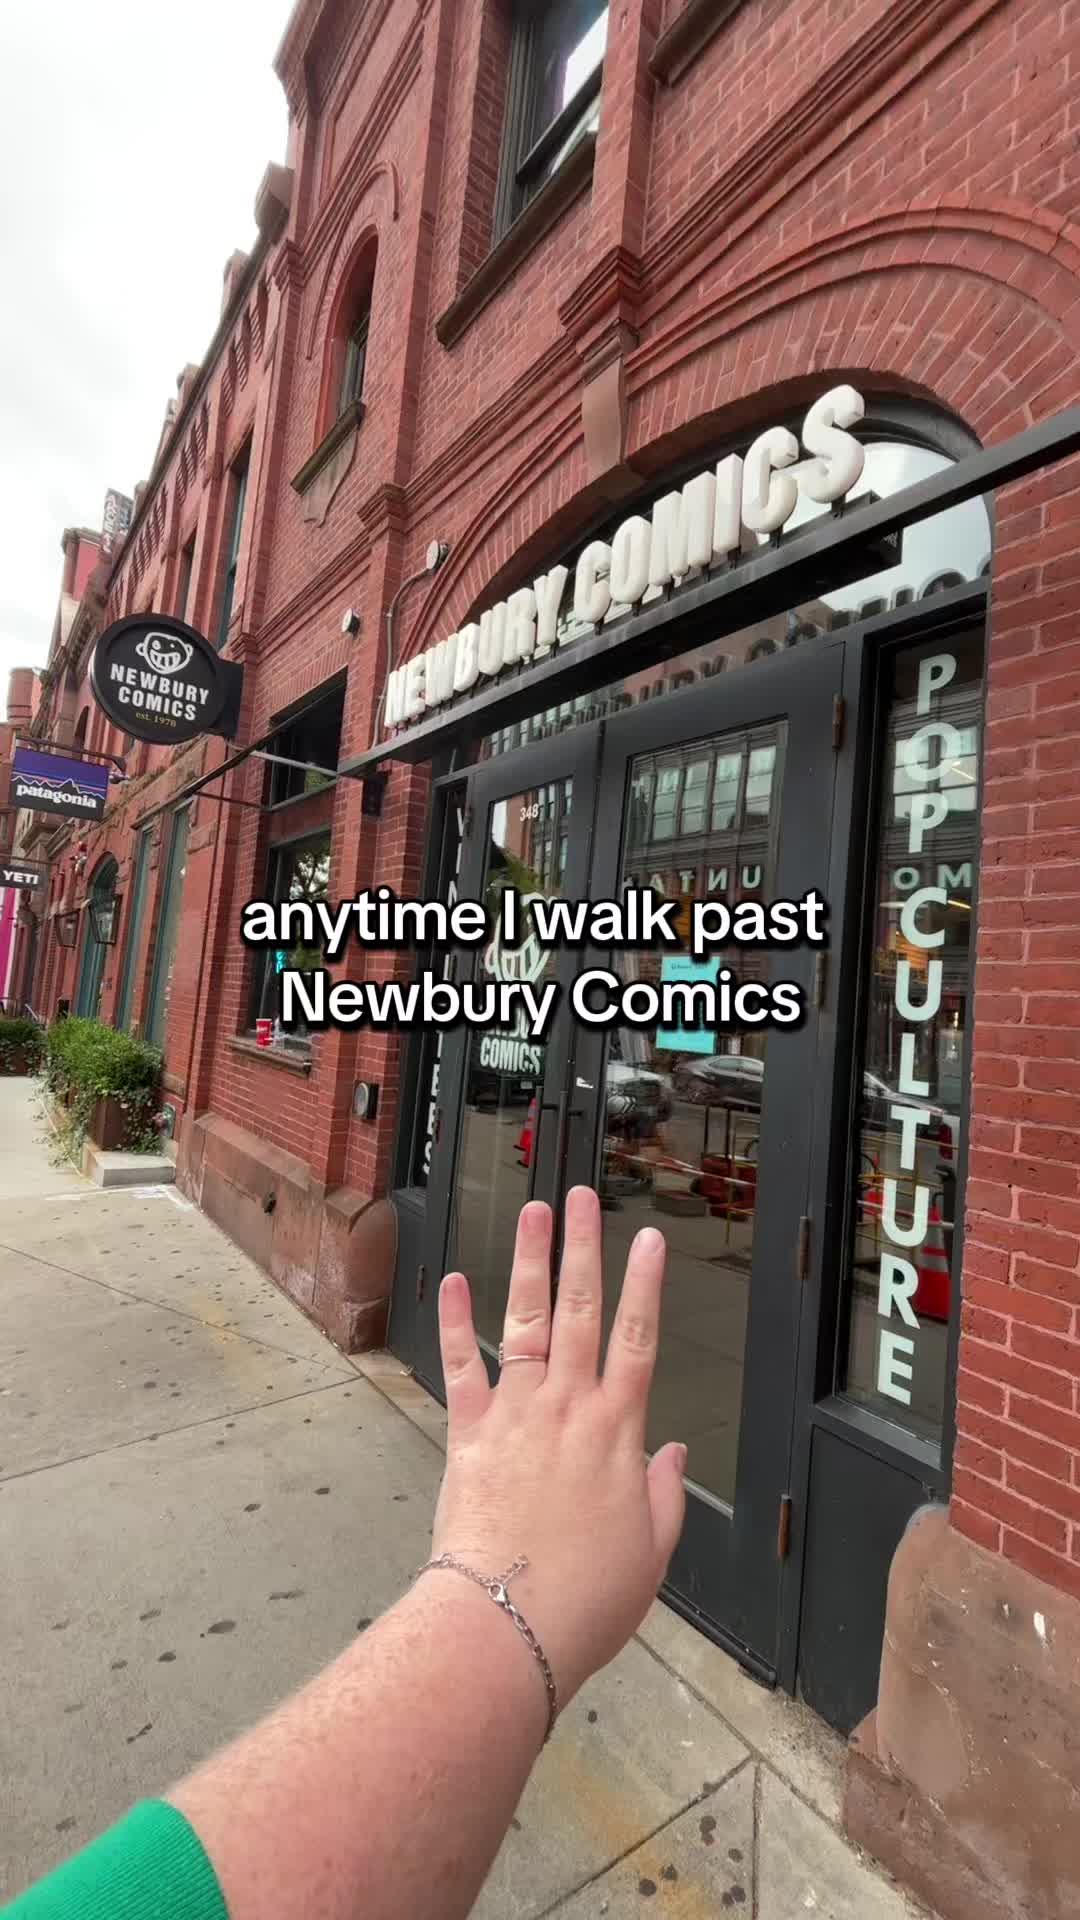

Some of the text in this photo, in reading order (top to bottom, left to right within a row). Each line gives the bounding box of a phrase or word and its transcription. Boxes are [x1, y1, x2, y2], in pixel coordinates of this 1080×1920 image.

[384, 384, 865, 728] NEWBURY COMICS
[110, 663, 209, 705] NEWBURY
[118, 686, 197, 721] COMICS
[904, 653, 961, 853] POP
[16, 784, 97, 808] patagonia
[519, 803, 539, 822] 348
[3, 870, 39, 885] YETI
[480, 1036, 542, 1076] COMICS
[877, 887, 947, 1406] CULTURE
